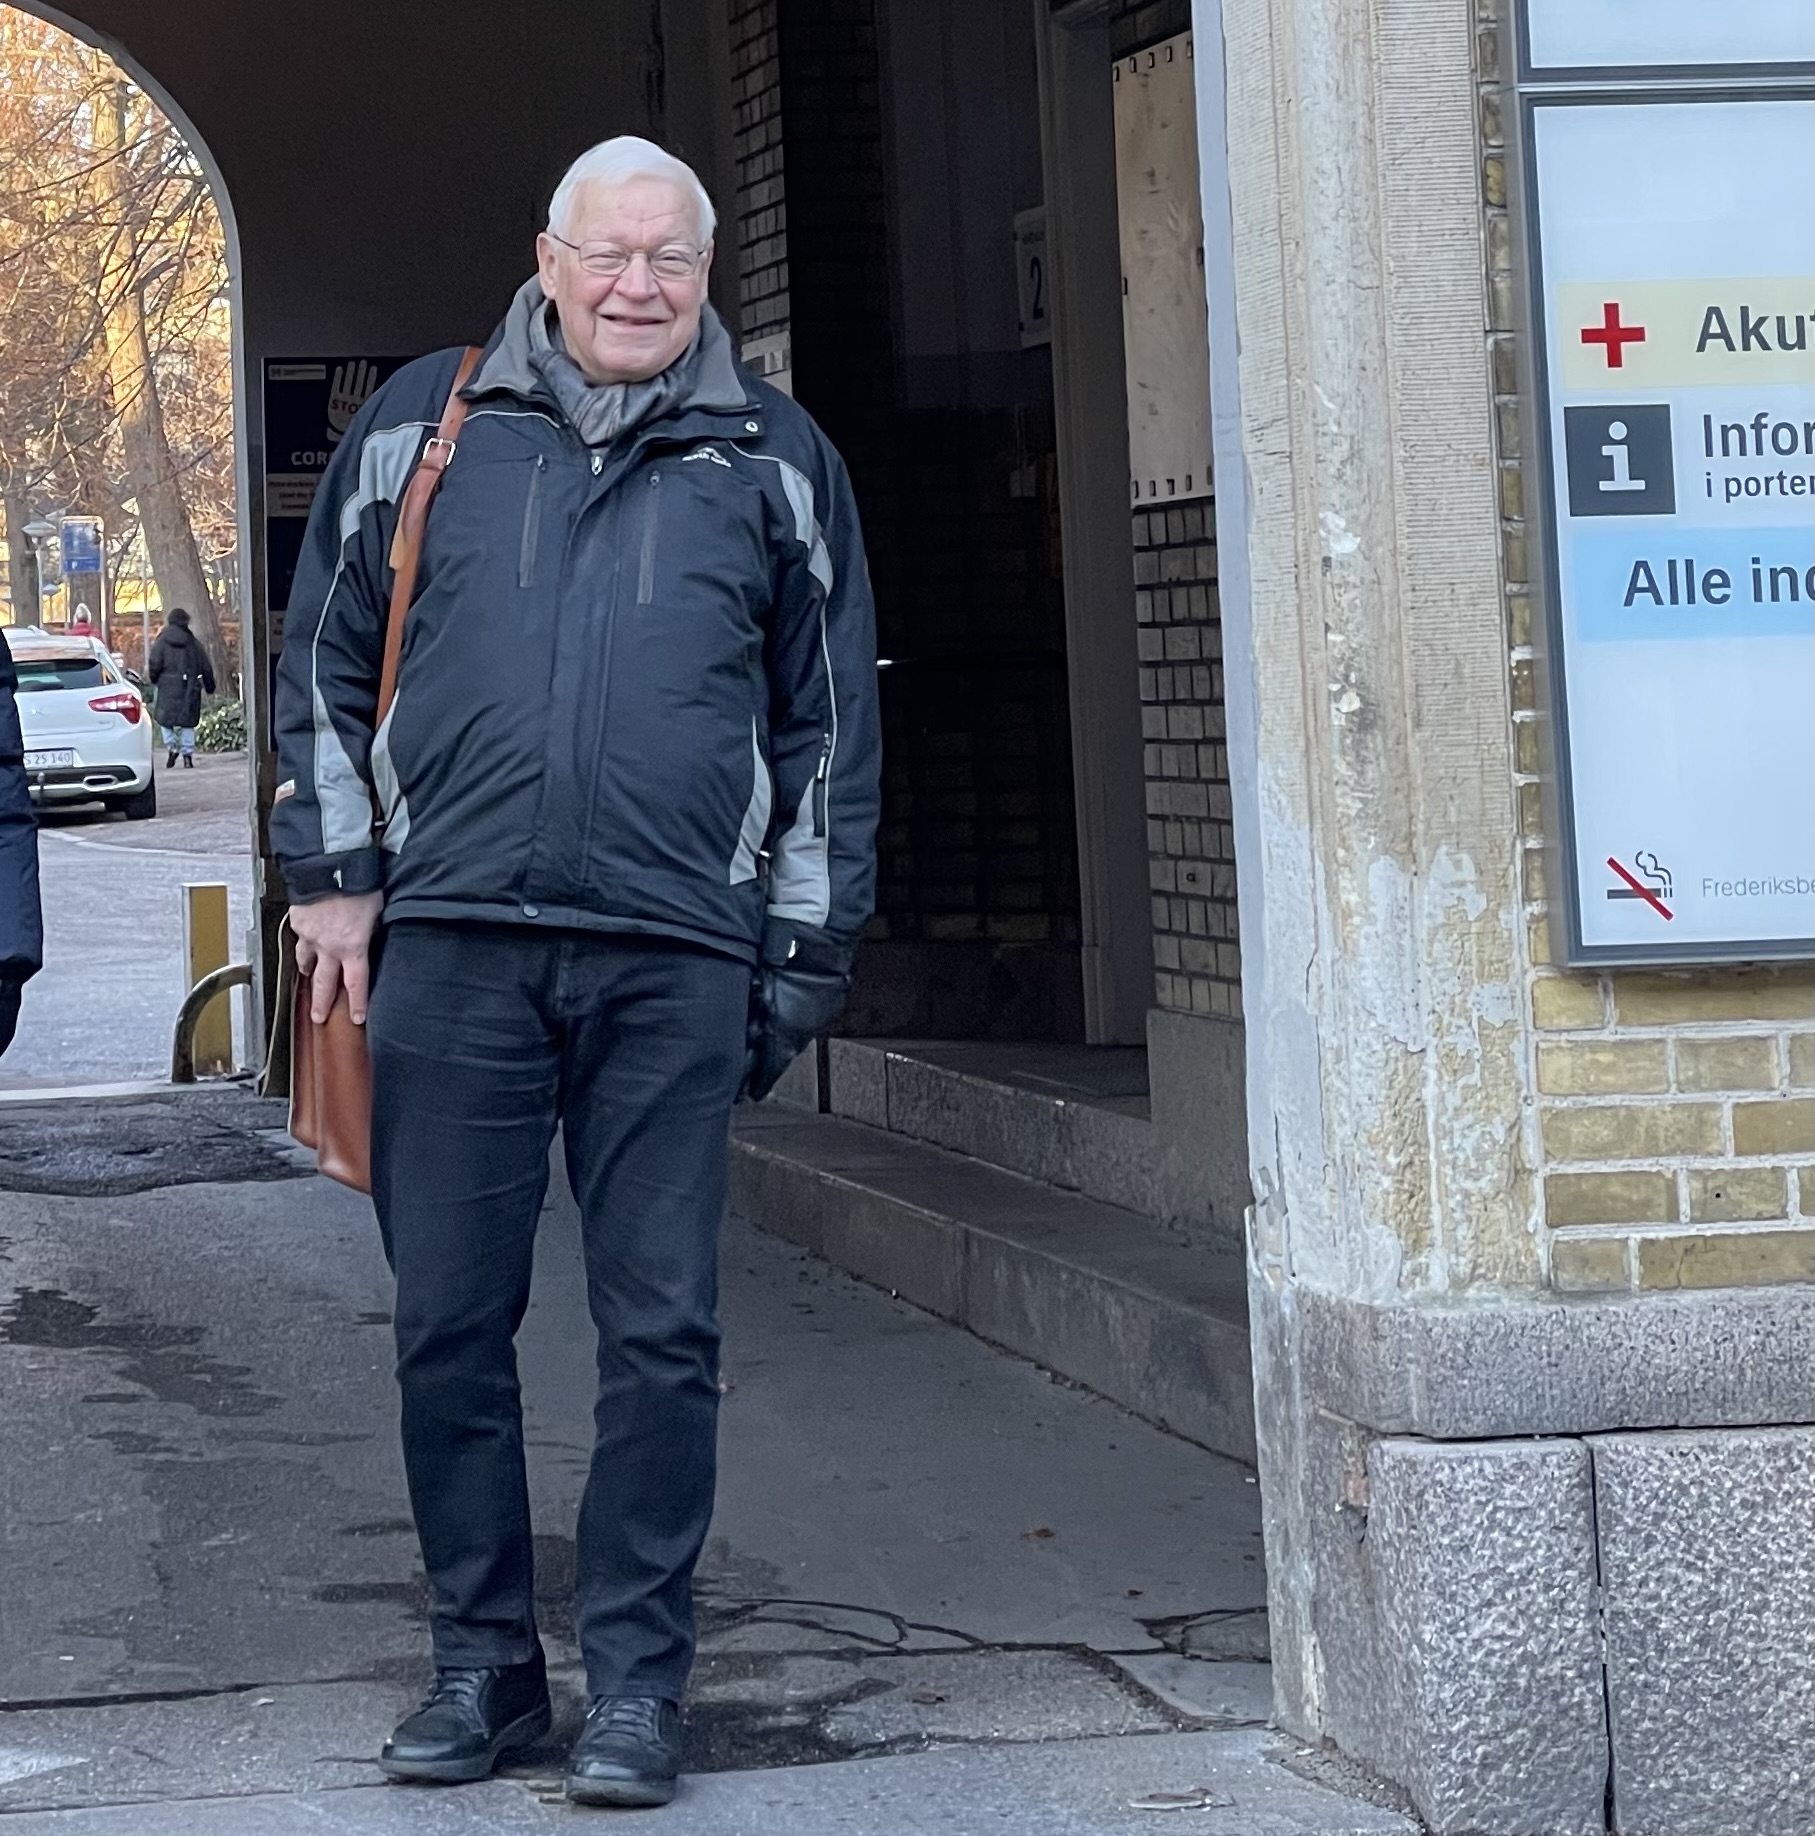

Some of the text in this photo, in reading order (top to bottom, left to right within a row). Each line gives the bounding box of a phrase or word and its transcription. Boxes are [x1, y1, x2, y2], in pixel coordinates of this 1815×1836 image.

[1030, 256, 1044, 320] 2
[331, 399, 363, 415] STO
[290, 450, 333, 466] COR
[1706, 471, 1712, 497] i
[1623, 558, 1732, 607] Alle
